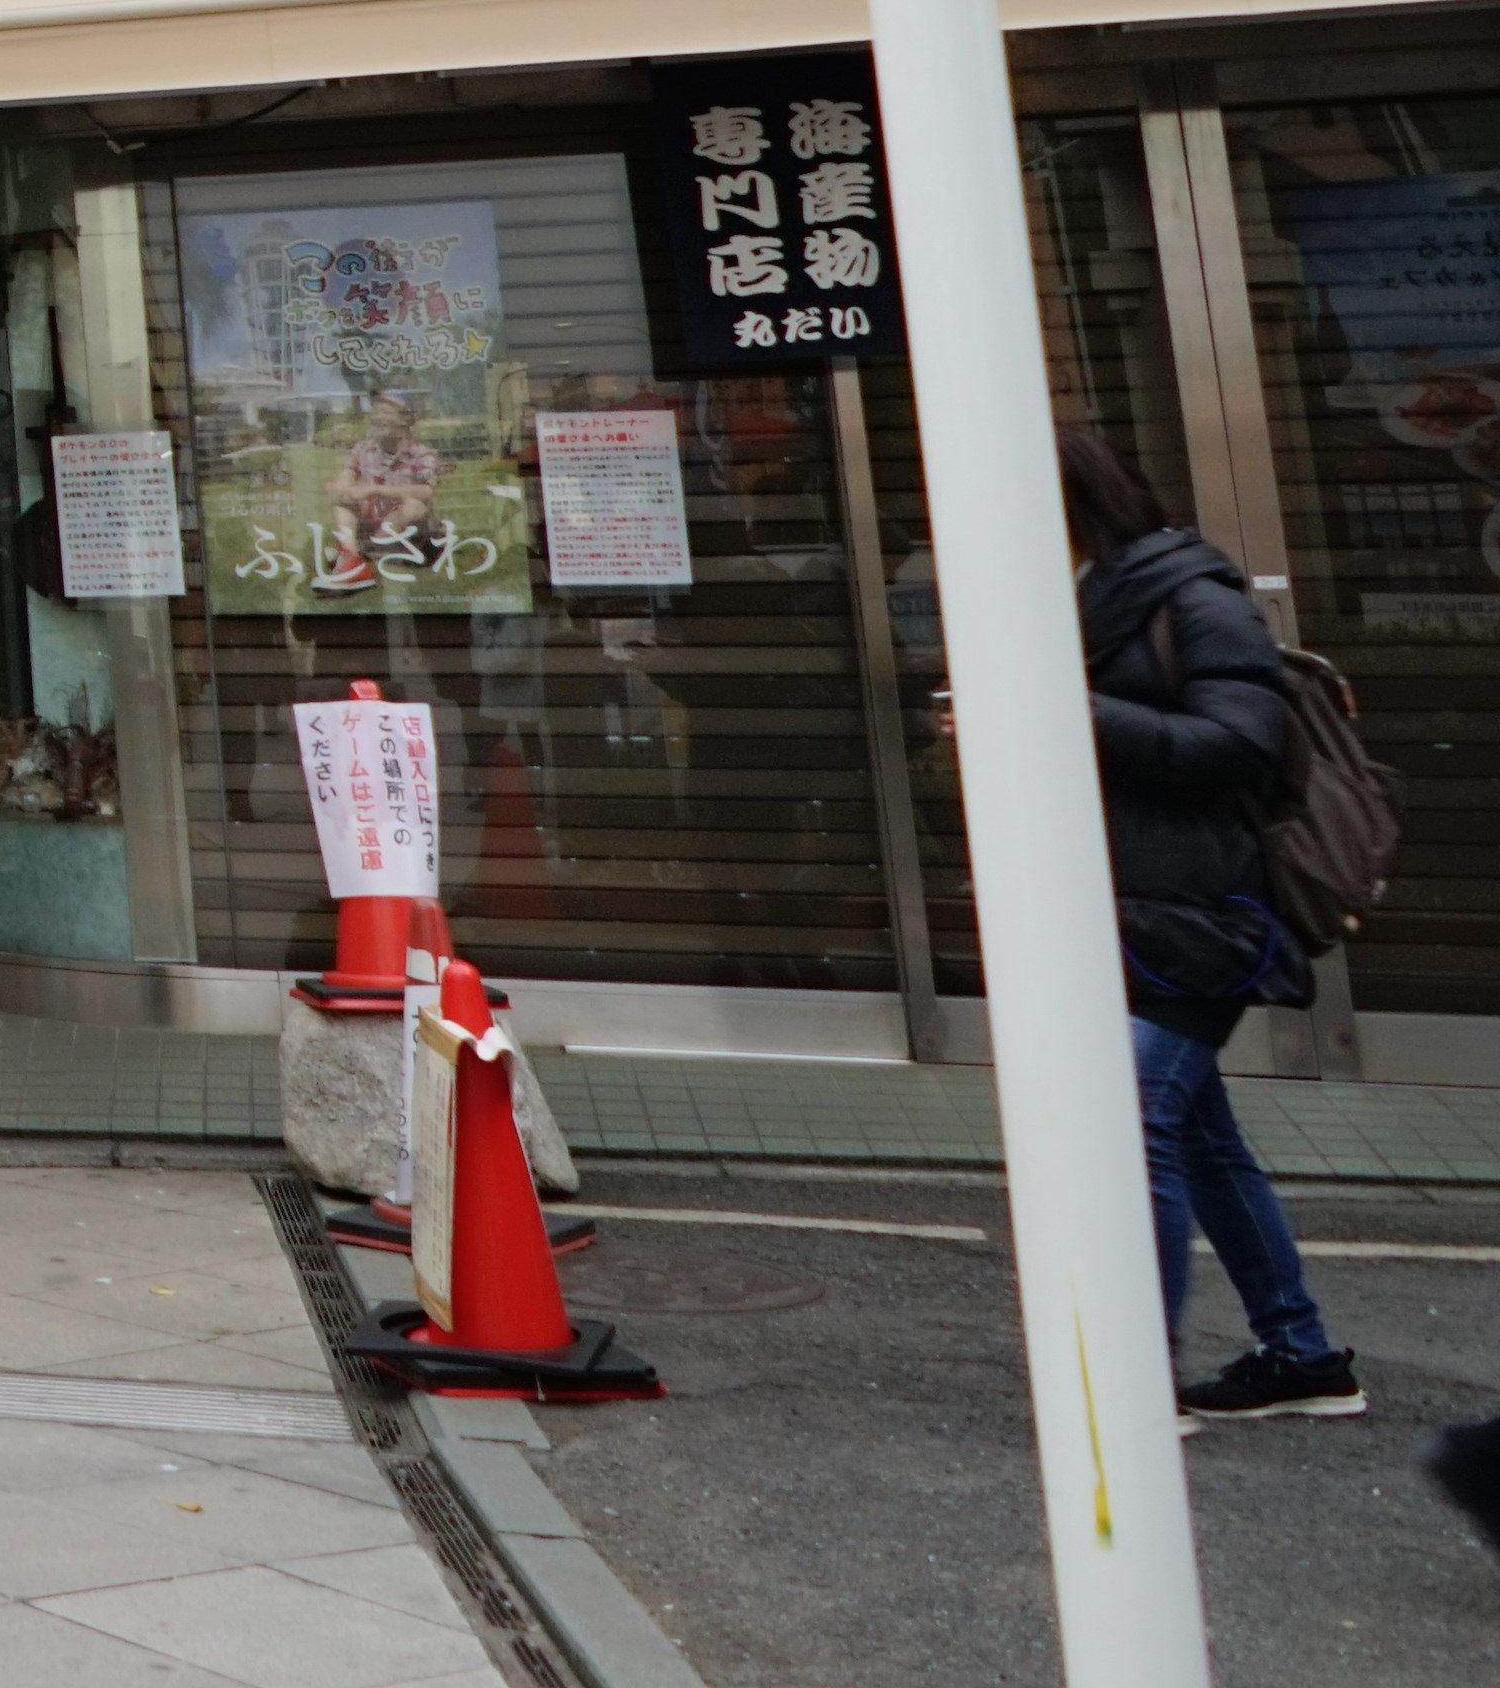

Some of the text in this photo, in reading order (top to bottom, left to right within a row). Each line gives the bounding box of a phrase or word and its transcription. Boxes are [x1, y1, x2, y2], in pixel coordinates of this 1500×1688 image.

[787, 98, 880, 290] 海産物
[732, 306, 871, 349] 丸だい
[234, 518, 498, 583] ふじさわ
[308, 715, 338, 804] ください
